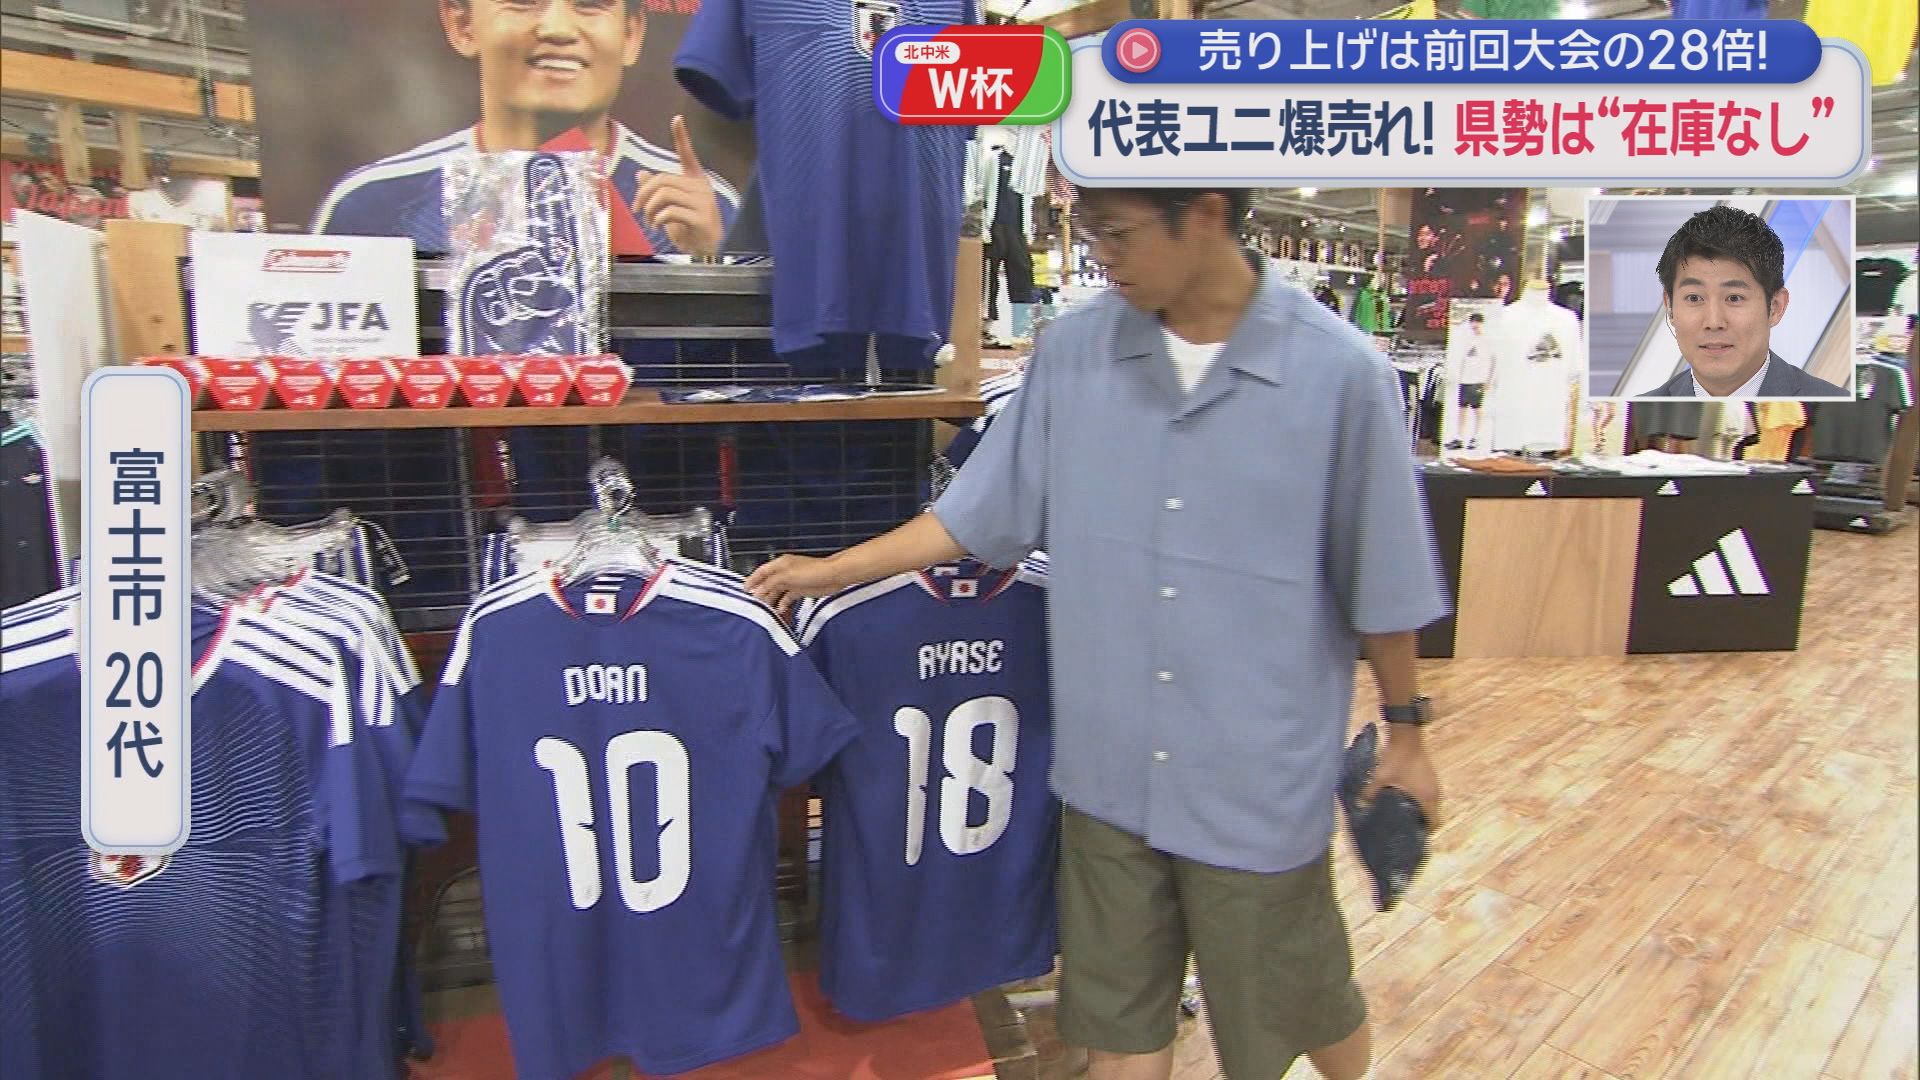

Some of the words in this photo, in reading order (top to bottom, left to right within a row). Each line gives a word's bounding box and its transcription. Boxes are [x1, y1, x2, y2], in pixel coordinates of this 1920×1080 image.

[310, 302, 390, 330] JFA
[916, 639, 1003, 680] AYASE
[563, 665, 648, 706] DOAN
[891, 696, 1019, 866] 18
[534, 730, 692, 914] 10
